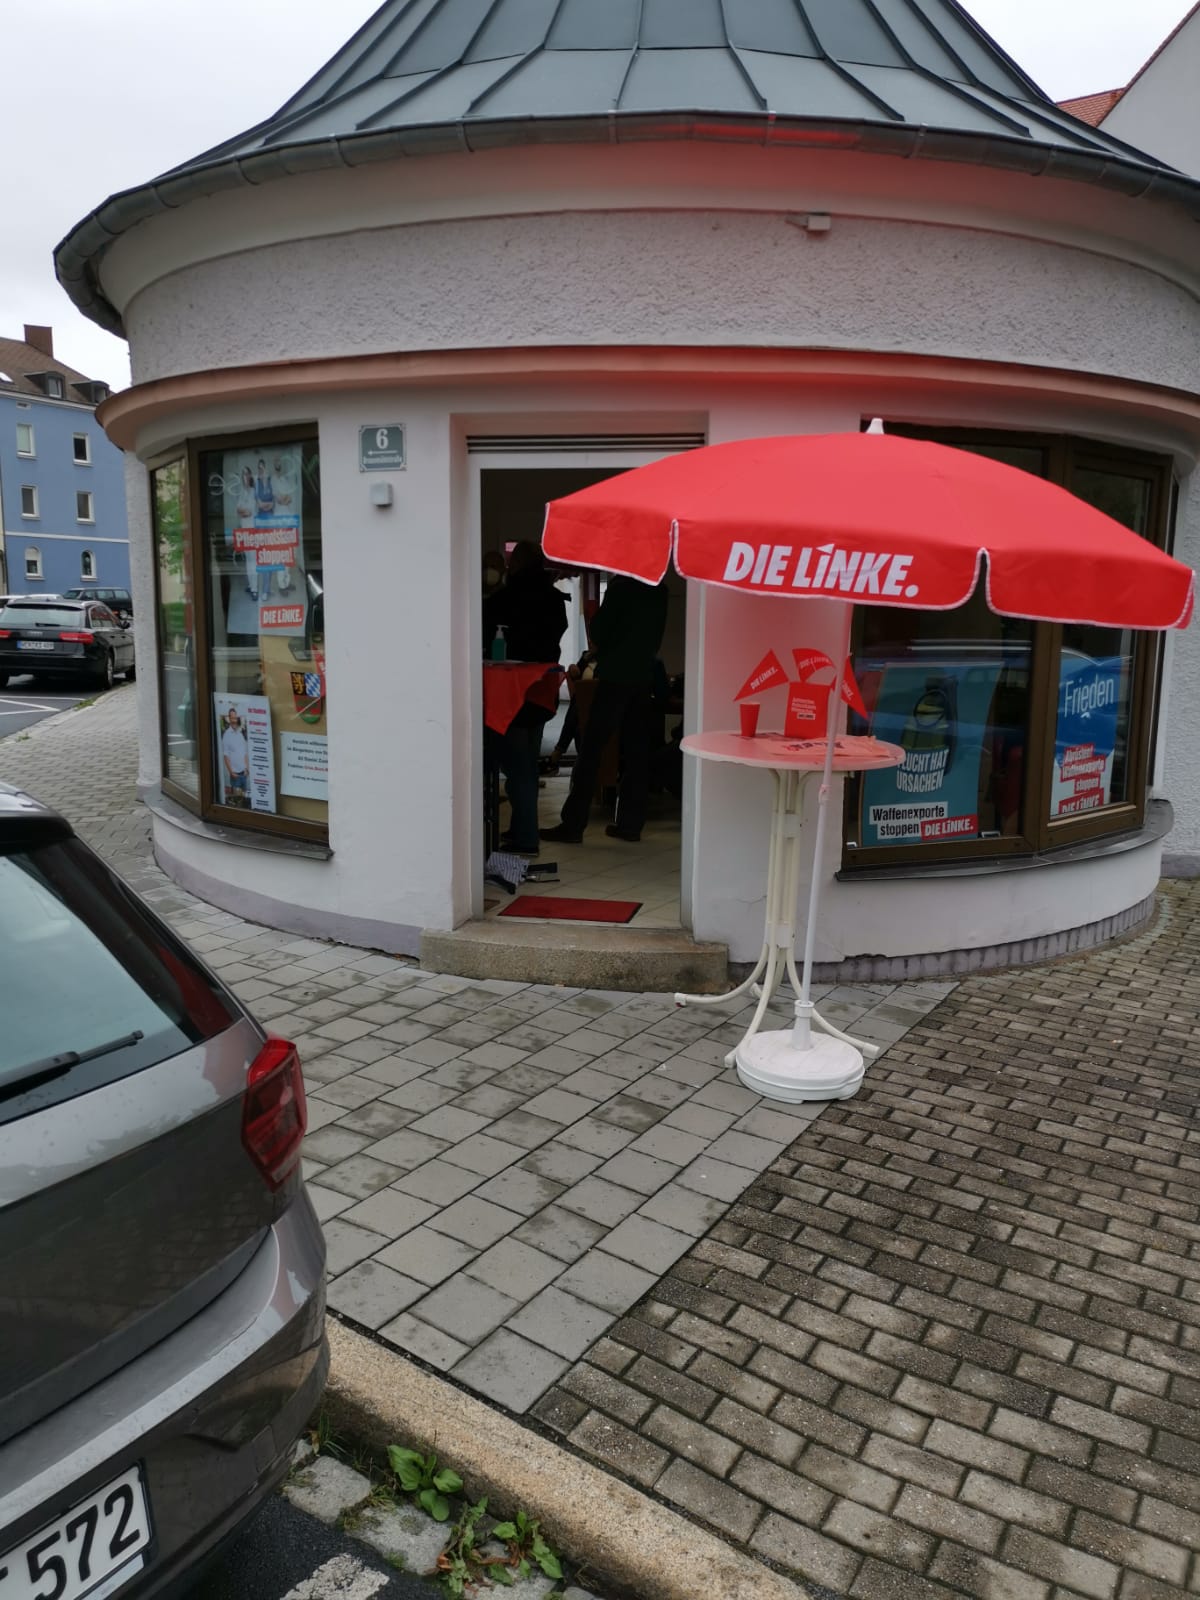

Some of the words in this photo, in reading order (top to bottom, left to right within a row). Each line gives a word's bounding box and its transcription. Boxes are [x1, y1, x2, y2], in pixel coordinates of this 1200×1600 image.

[376, 428, 389, 449] 6
[722, 541, 792, 586] DIE
[263, 610, 277, 624] DIE
[1064, 674, 1114, 718] Frieden
[930, 748, 949, 771] HAT
[896, 769, 944, 793] URSACHEN
[872, 805, 945, 822] Waffenexporte
[880, 822, 919, 837] stoppen
[925, 824, 942, 837] DIE
[26, 1483, 141, 1600] 572
